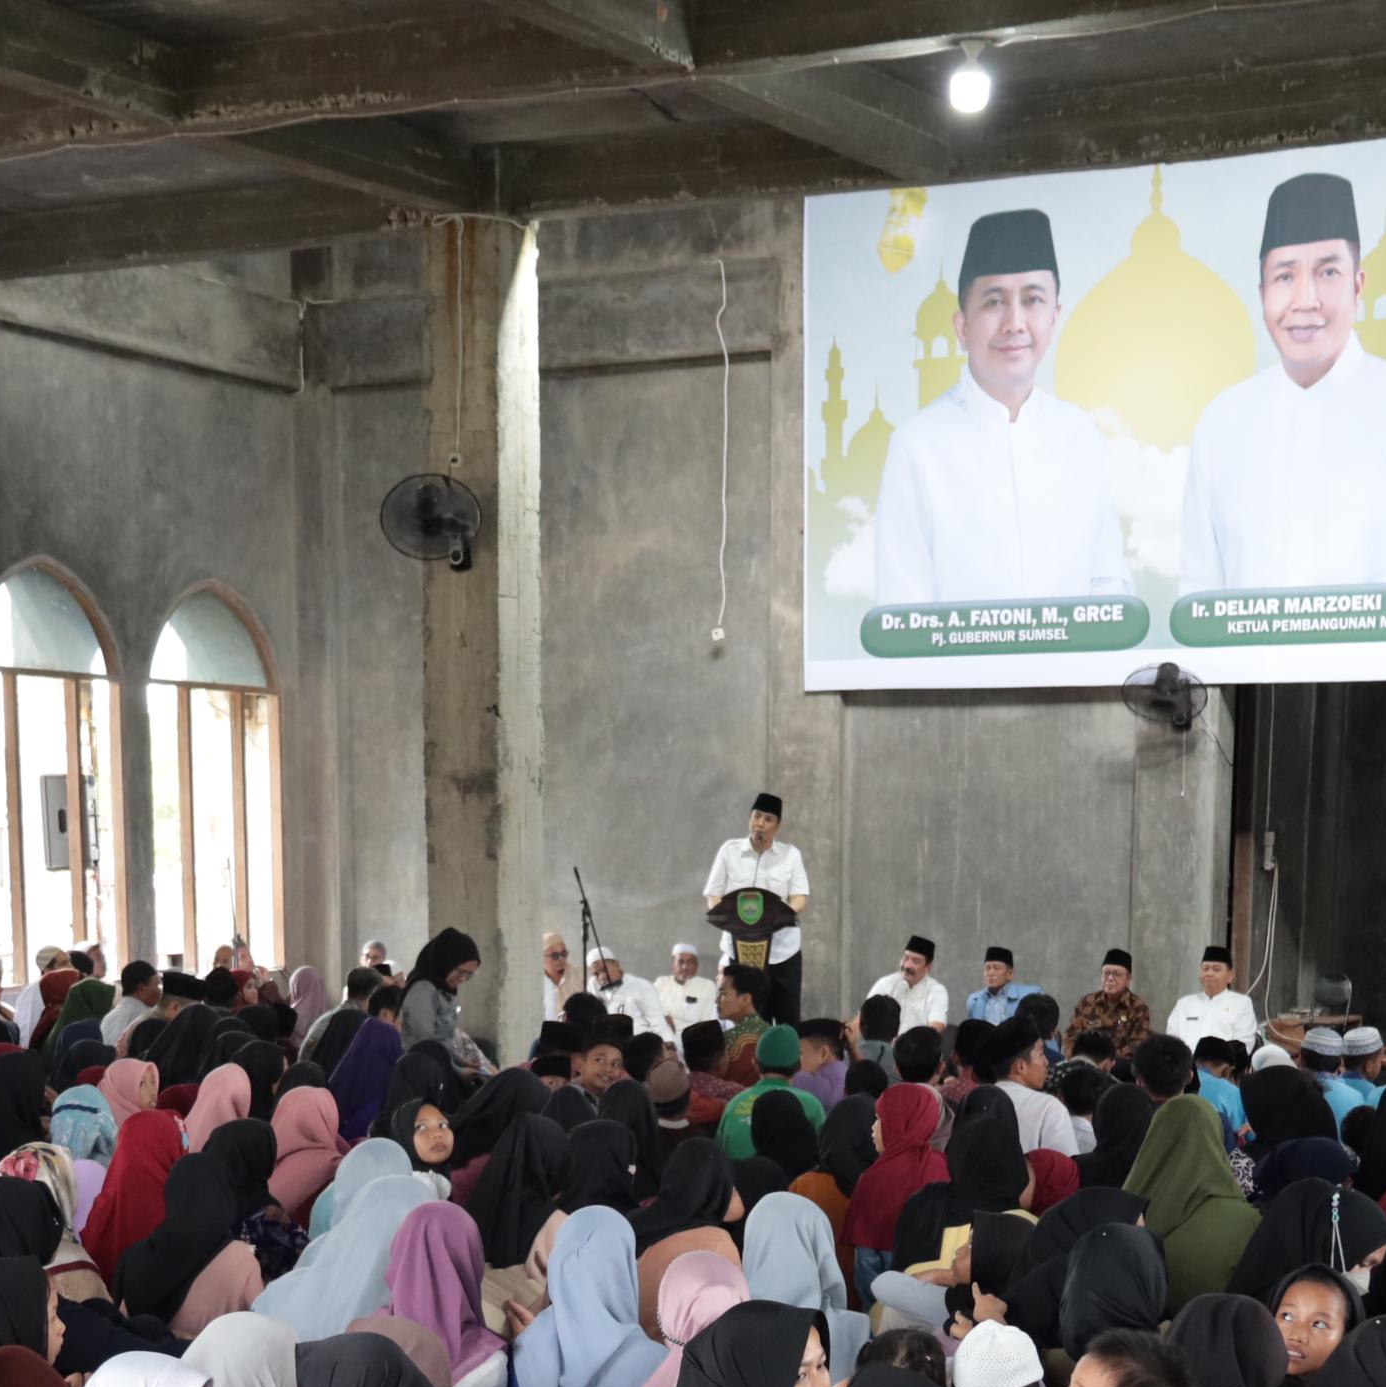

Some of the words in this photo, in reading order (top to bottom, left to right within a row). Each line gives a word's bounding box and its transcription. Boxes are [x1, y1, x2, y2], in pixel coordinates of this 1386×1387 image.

[1192, 601, 1210, 618] Ir.
[1214, 598, 1279, 617] DELIAR
[1284, 594, 1382, 615] MARZOEKI
[881, 613, 905, 630] Dr.
[909, 612, 944, 629] Drs.
[948, 611, 965, 627] A.
[970, 607, 1037, 627] FATONI,
[1042, 607, 1069, 626] M.,
[1073, 604, 1124, 622] GRCE
[1227, 620, 1270, 635] KETUA
[1272, 616, 1376, 633] PEMBANGUNAN
[949, 630, 1015, 645] GUBERNUR
[1018, 628, 1069, 642] SUMSEL
